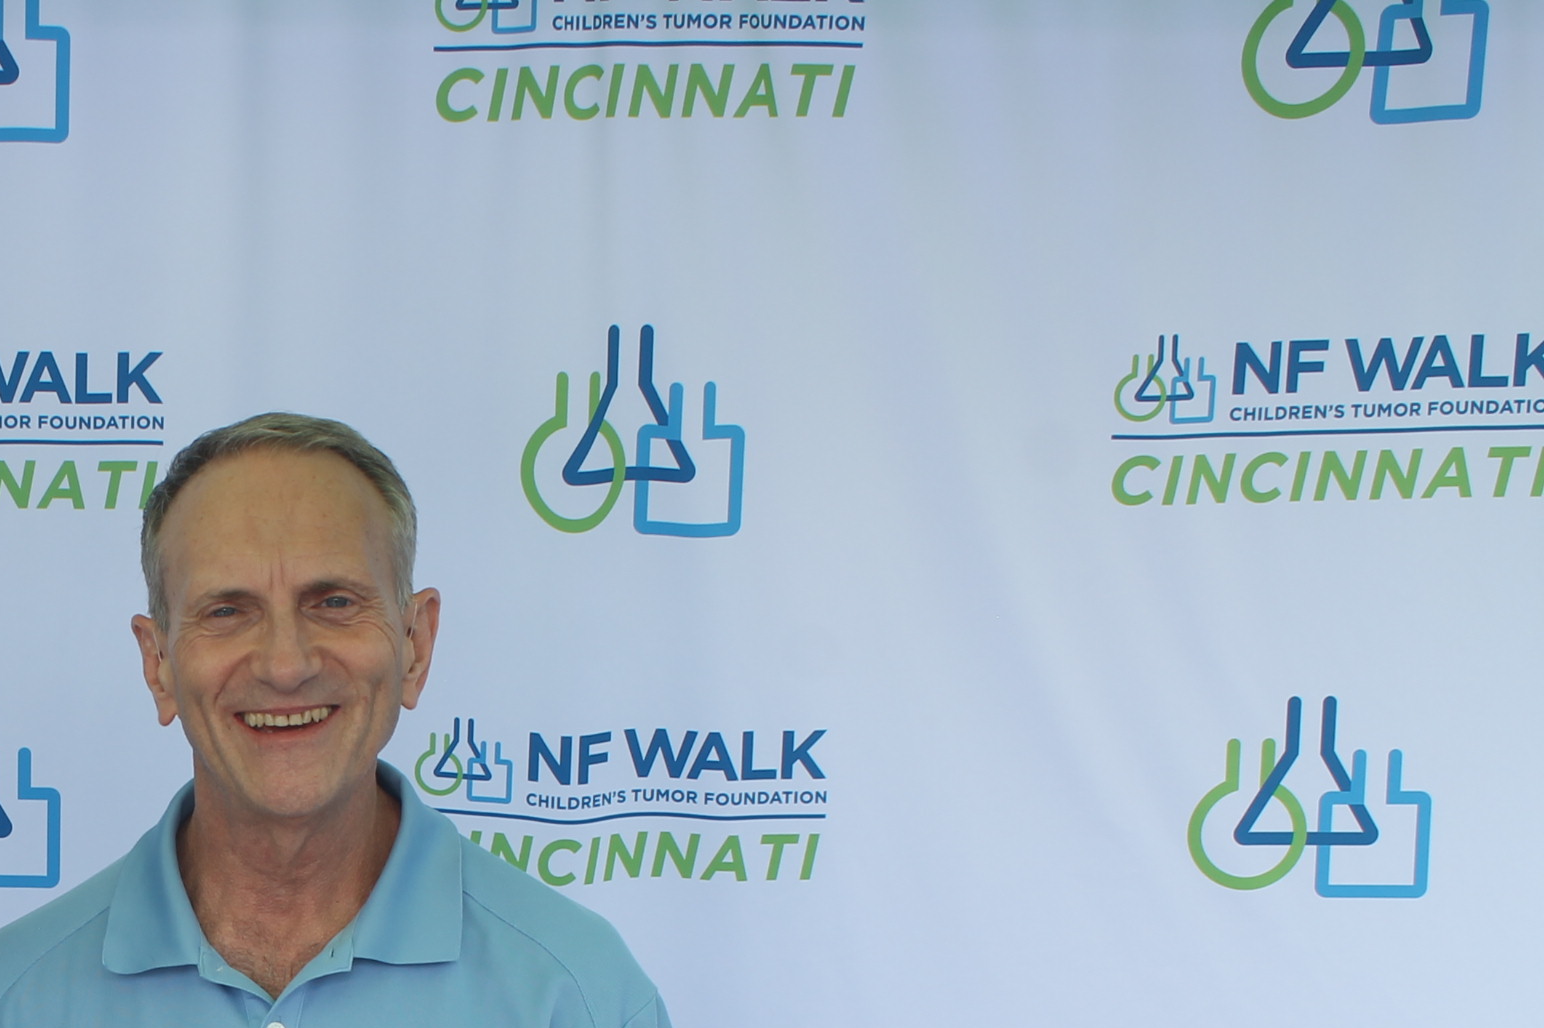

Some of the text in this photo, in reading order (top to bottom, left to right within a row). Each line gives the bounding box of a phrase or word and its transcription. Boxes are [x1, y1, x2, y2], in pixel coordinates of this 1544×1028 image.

[553, 14, 865, 30] CHILDREN'S TUMOR FOUNDATION
[435, 64, 856, 122] CINCINNATI
[1232, 340, 1329, 395] NF
[1230, 400, 1544, 422] CHILDREN'S TUMOR FOUNDATIO
[38, 415, 164, 430] FOUNDATION
[528, 729, 827, 785] NF WALK
[526, 789, 827, 810] CHILDREN'S TUMOR FOUNDATION
